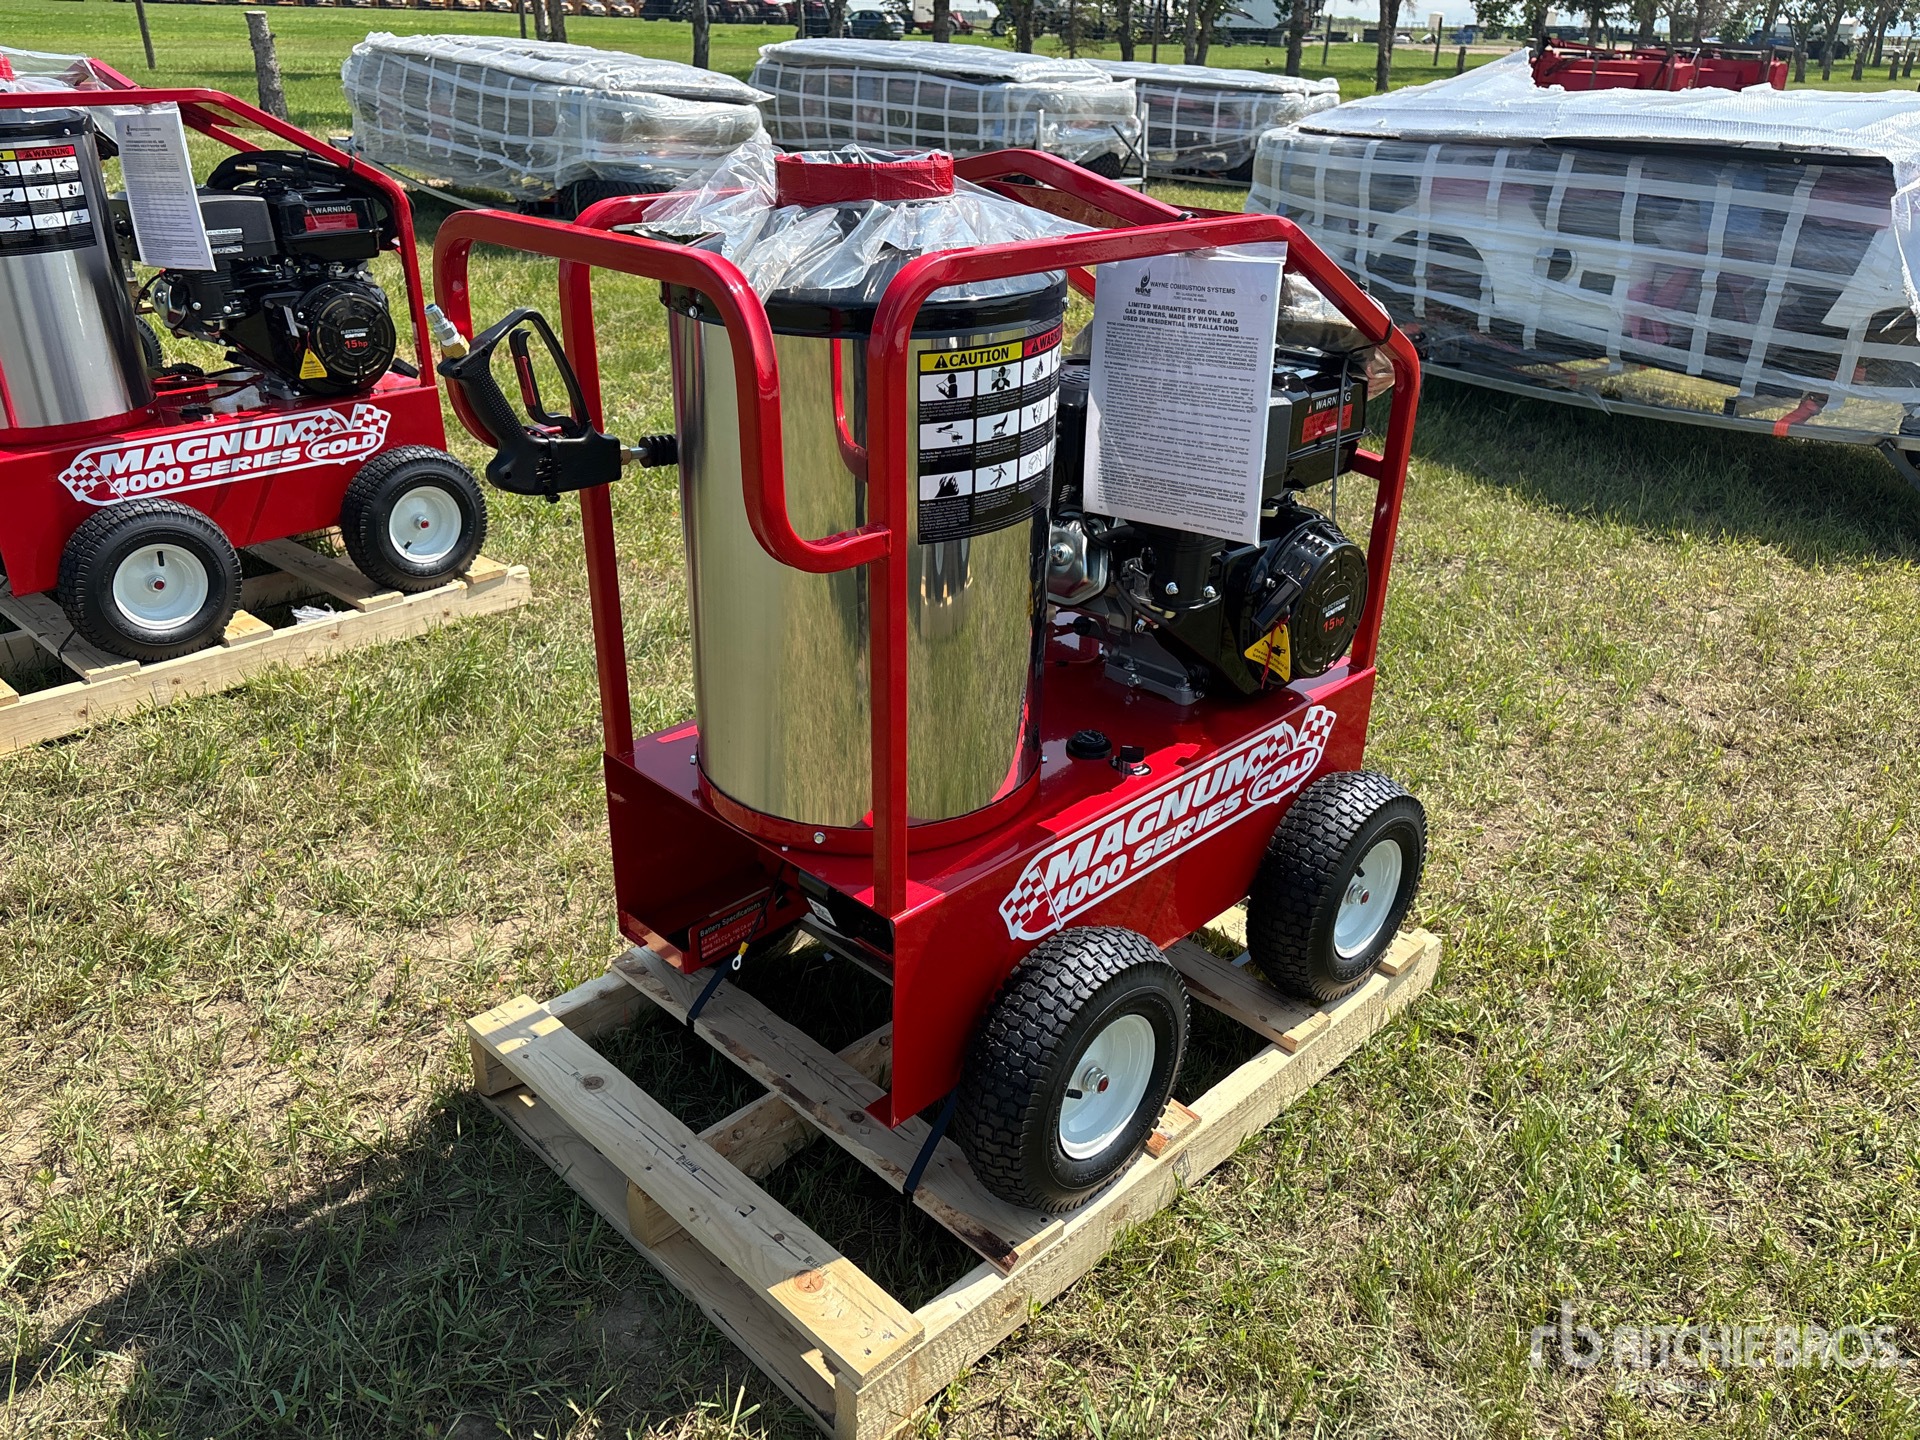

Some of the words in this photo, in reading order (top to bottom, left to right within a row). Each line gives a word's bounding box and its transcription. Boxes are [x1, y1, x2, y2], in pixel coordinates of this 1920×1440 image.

[33, 148, 70, 158] WARNING
[314, 205, 352, 214] WARNING
[1150, 281, 1169, 290] WAYNE
[1170, 283, 1206, 292] COMBUSTION
[1207, 286, 1236, 295] SYSTEMS
[1125, 308, 1137, 316] GAS
[1138, 309, 1167, 319] BURNERS,
[1168, 312, 1186, 321] MADE
[1198, 315, 1222, 324] WAYNE
[1223, 317, 1238, 325] AND
[1128, 301, 1152, 310] LIMITED
[1152, 303, 1191, 313] WARRANTIES
[1192, 307, 1206, 315] FOR
[1207, 308, 1219, 316] OIL
[1221, 310, 1235, 318] AND
[1123, 315, 1138, 323] USED
[1146, 317, 1186, 328] RESIDENTIAL
[1187, 320, 1239, 332] INSTALLATIONS
[949, 347, 1009, 367] CAUTION
[1315, 391, 1352, 410] WARNG
[100, 421, 308, 476] MAGNUM
[109, 468, 184, 494] 4000
[190, 446, 300, 480] SERIES
[311, 435, 376, 458] GOLD
[1323, 616, 1345, 633] 15hp
[1043, 748, 1266, 889] MAGNUM
[1048, 855, 1127, 916] 4000
[1130, 787, 1246, 870] SERIES
[1251, 752, 1314, 798] GOLD
[700, 923, 721, 937] Battery
[721, 902, 761, 926] Specifications
